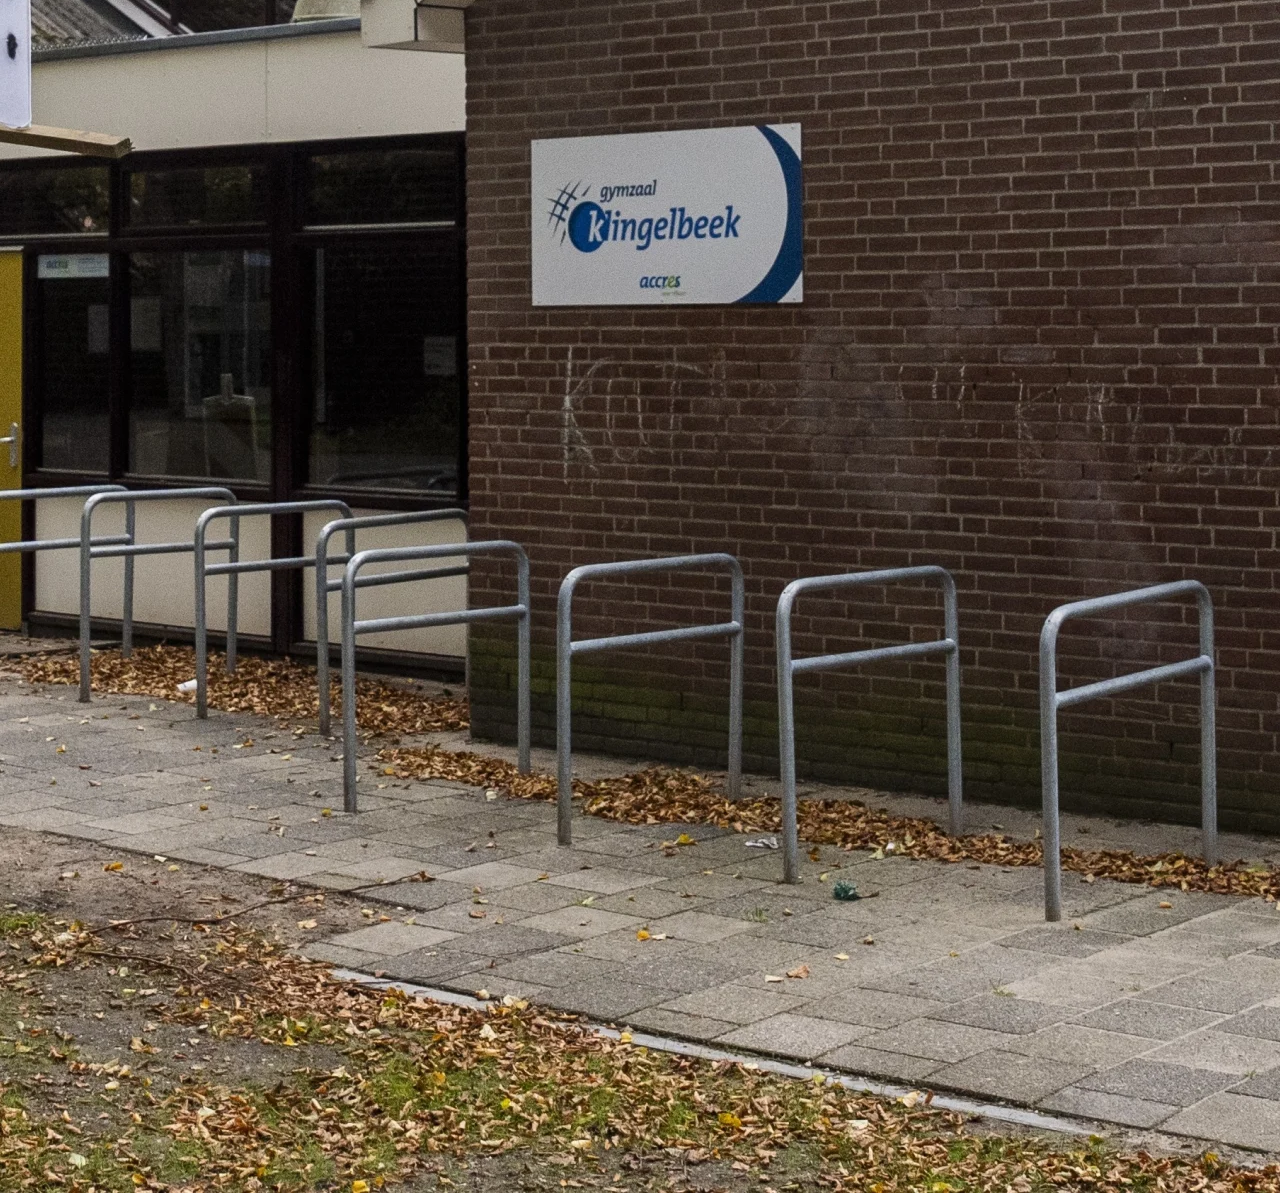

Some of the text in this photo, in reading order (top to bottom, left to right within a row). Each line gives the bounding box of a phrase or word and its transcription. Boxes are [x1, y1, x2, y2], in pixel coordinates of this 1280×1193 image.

[600, 179, 658, 203] gymzaal
[587, 205, 741, 251] klingelbeek
[639, 275, 682, 289] accres
